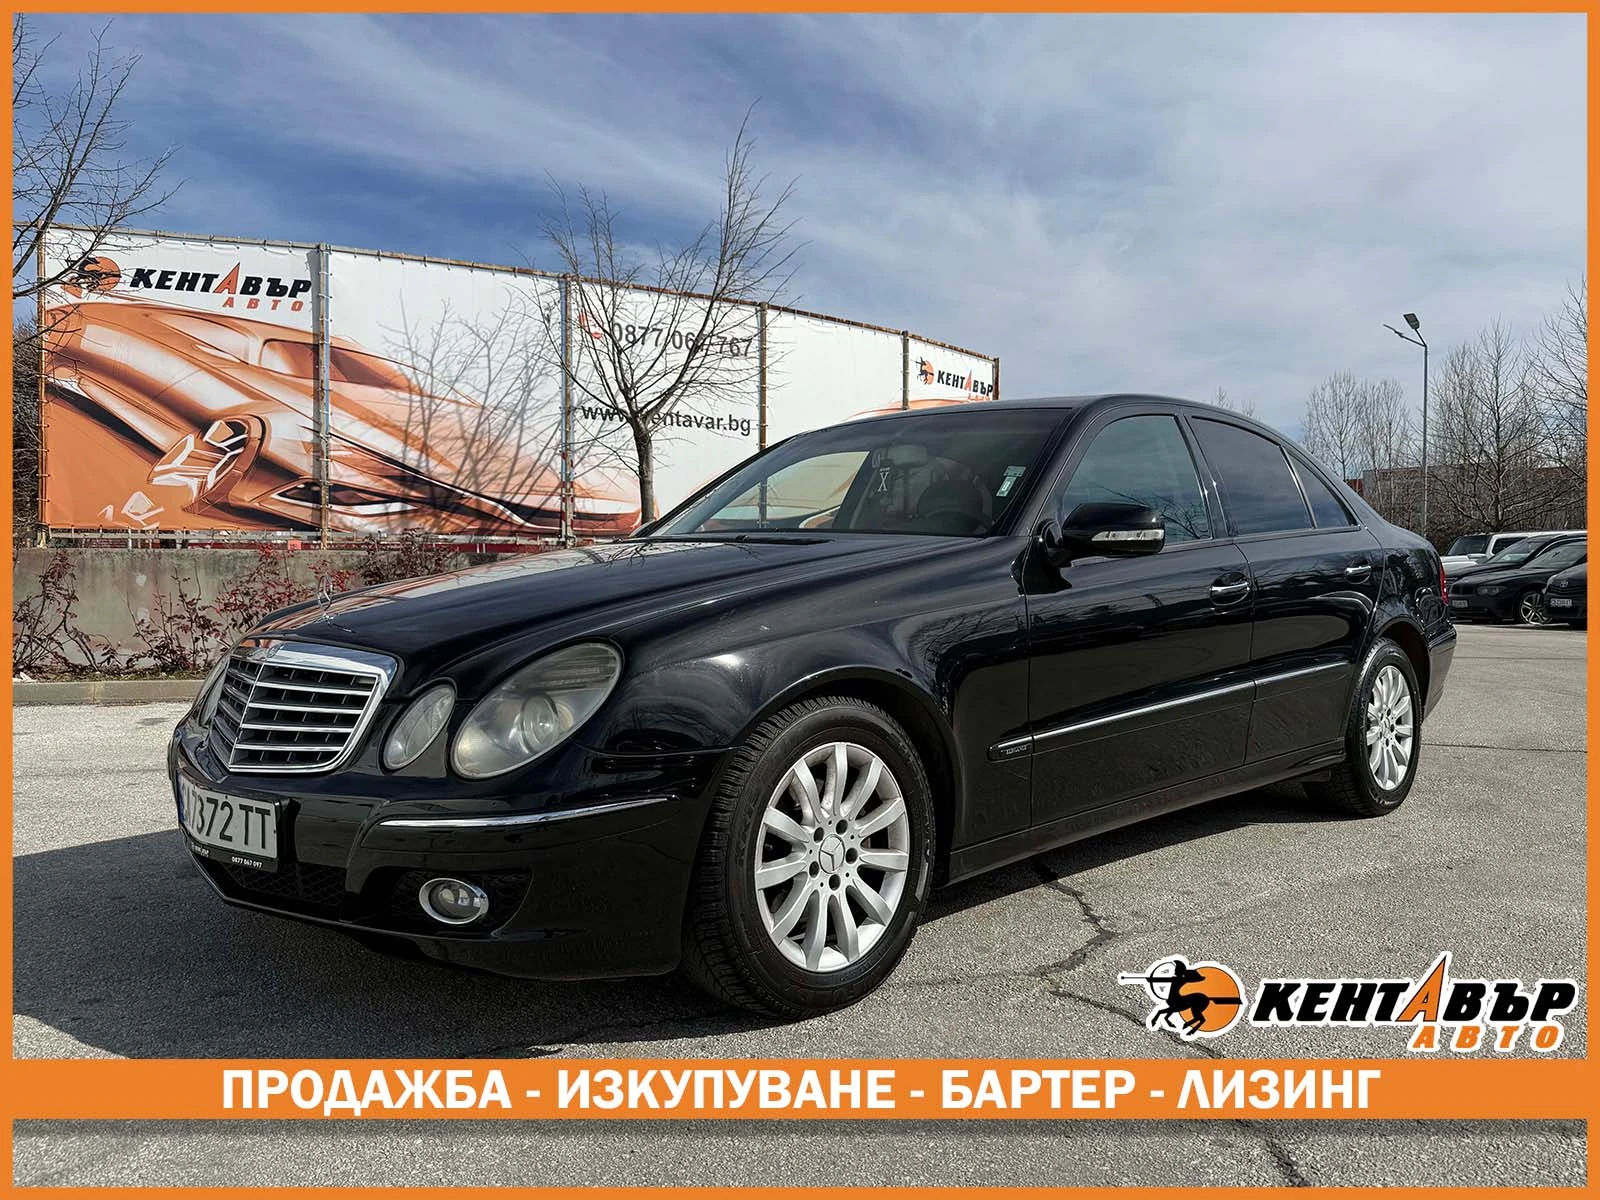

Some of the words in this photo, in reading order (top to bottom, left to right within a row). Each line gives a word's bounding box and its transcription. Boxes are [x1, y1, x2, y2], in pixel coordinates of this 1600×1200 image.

[130, 262, 312, 298] КЕНТАВЪР
[223, 297, 304, 312] АВТО
[613, 322, 663, 347] 0877
[937, 369, 993, 396] КЕНТАВЪР
